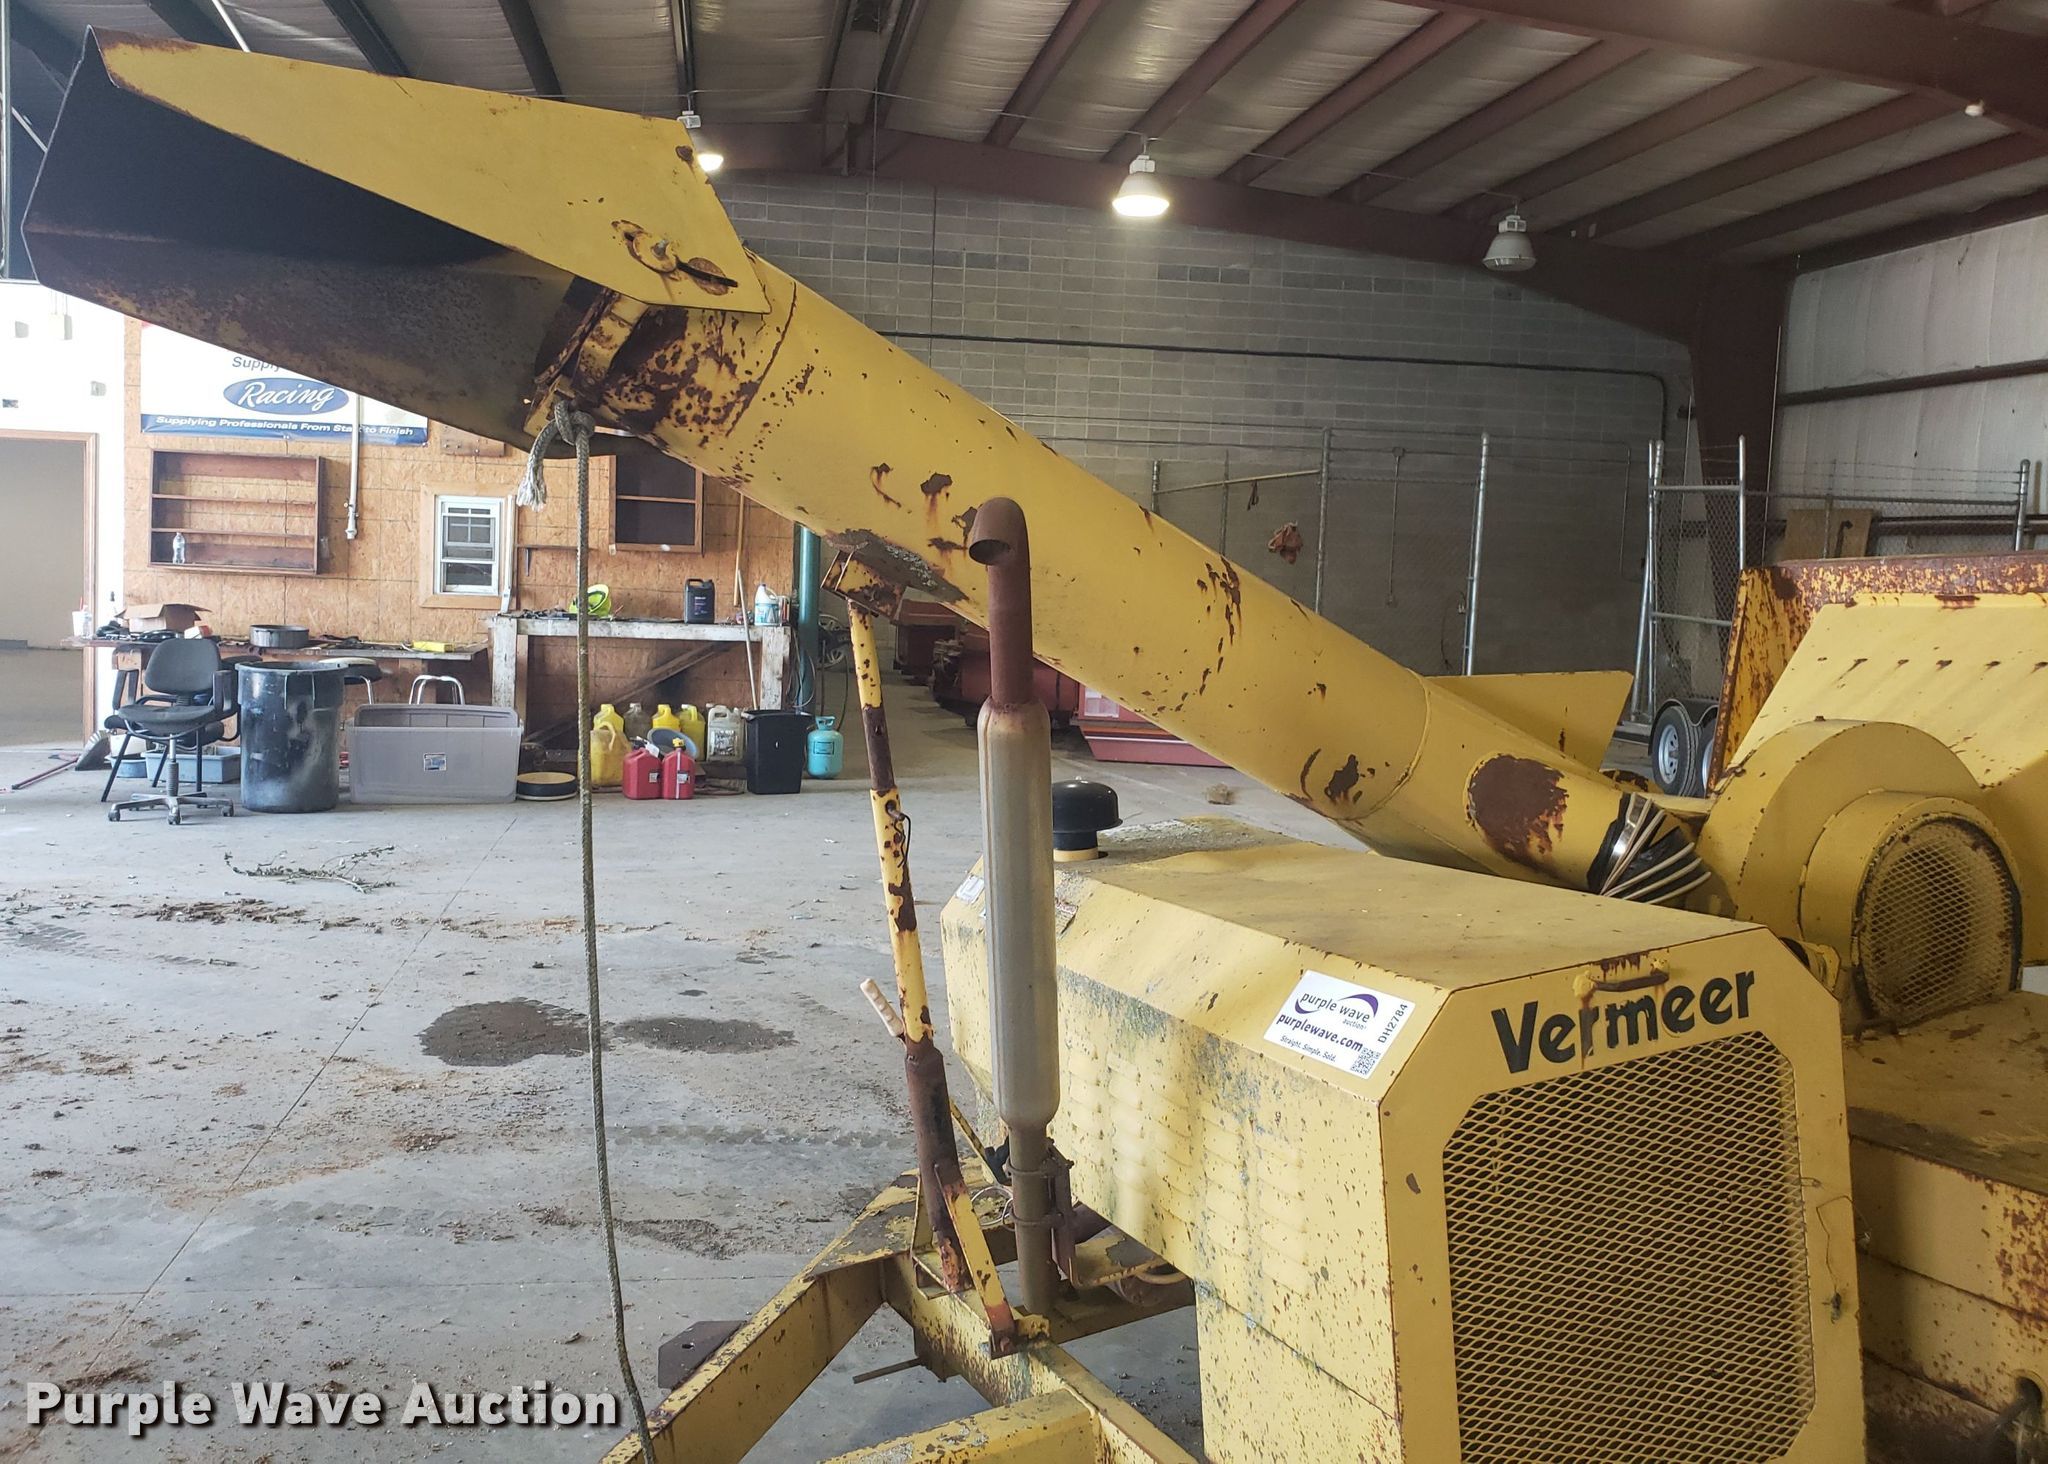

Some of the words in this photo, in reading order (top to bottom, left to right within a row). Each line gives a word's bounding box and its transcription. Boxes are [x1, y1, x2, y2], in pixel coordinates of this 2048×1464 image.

[238, 381, 335, 412] Racing
[156, 416, 217, 427] Supplying
[219, 419, 298, 430] Professionals
[300, 422, 331, 432] From
[333, 424, 362, 433] Sta
[365, 425, 377, 434] to
[379, 426, 413, 435] Finish
[1300, 992, 1337, 1012] purple
[1339, 1005, 1371, 1023] wave
[1491, 970, 1755, 1074] Vermeer
[1276, 1012, 1364, 1052] purplewave.com
[1342, 1019, 1364, 1029] auction
[1280, 1035, 1301, 1048] Straight.
[1302, 1044, 1321, 1056] Simple.
[1322, 1052, 1336, 1062] Sold.
